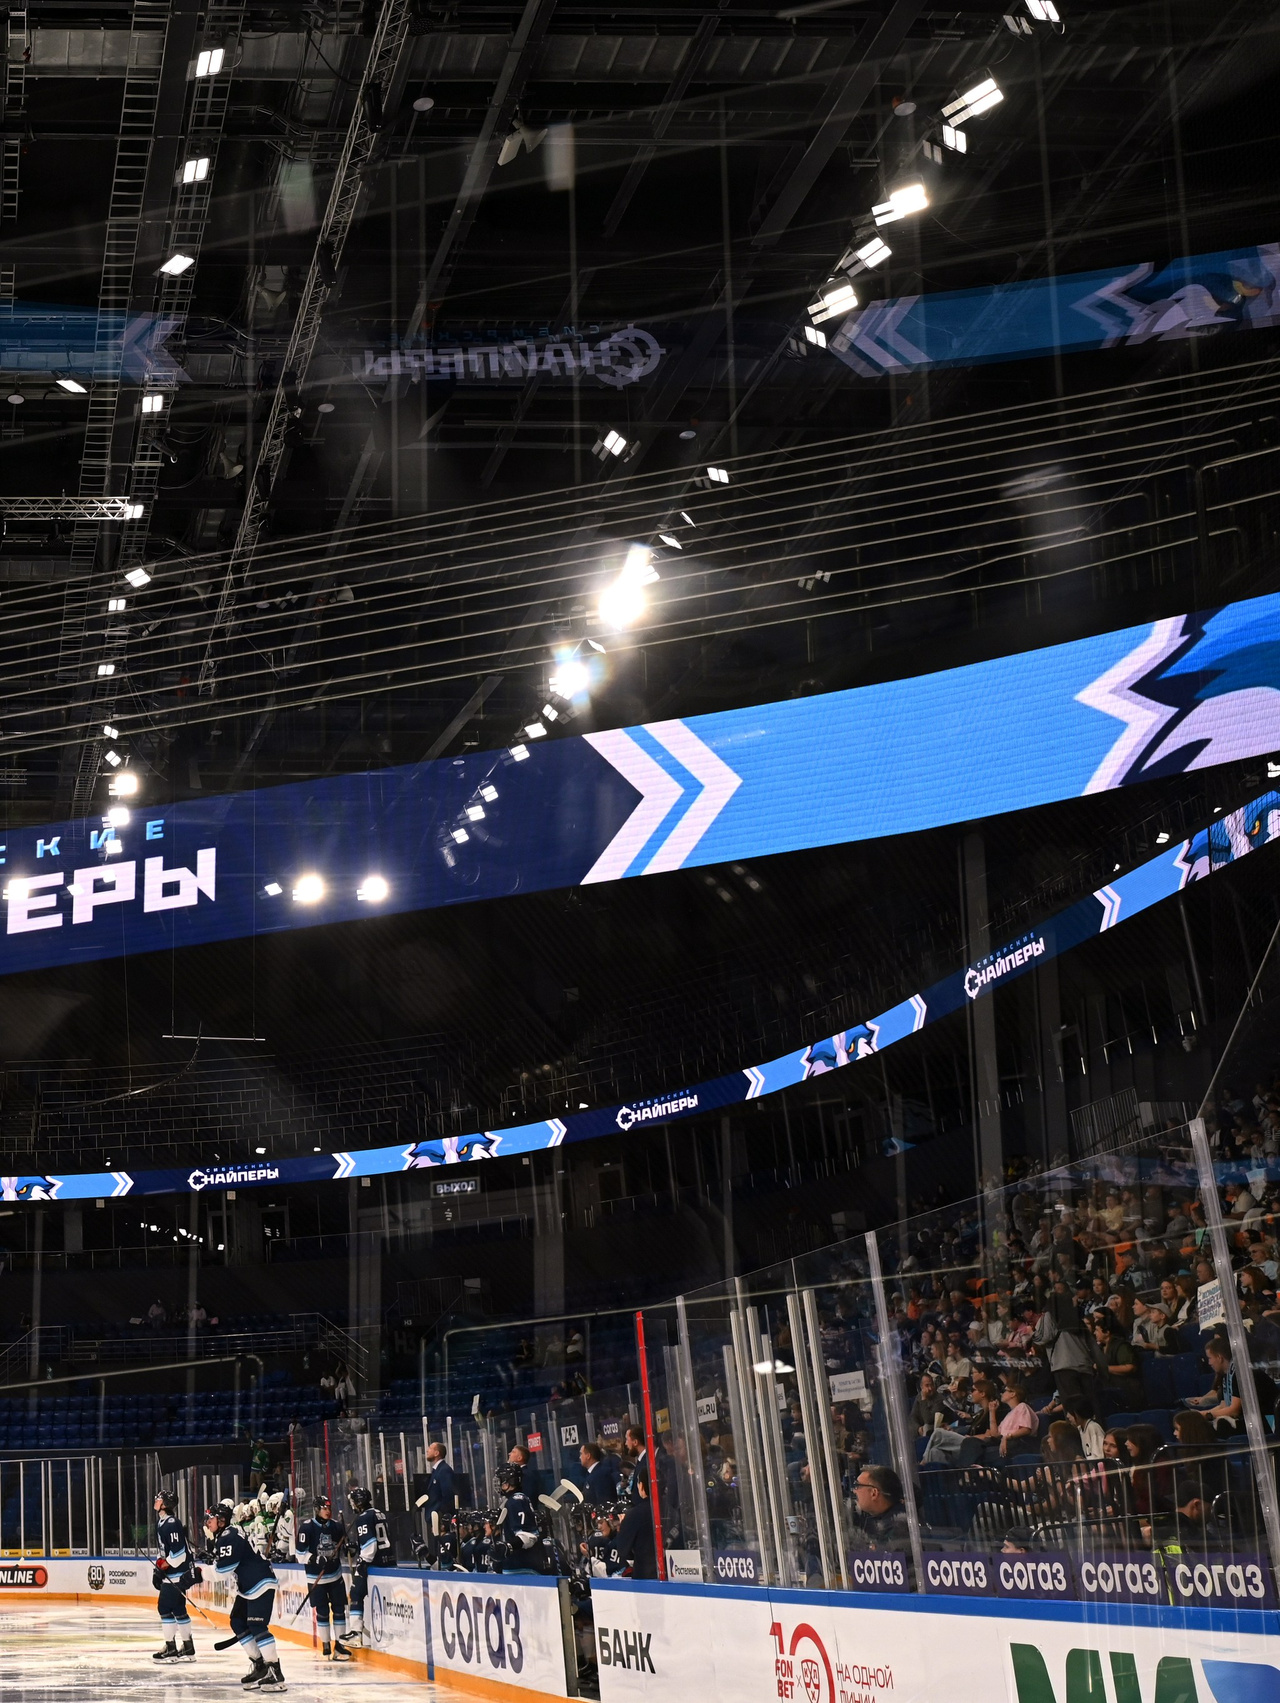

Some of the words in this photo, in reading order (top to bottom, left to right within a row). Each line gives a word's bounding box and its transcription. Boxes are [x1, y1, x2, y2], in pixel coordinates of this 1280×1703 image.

[963, 937, 1045, 1000] СНАЙПЕРЫ
[615, 1094, 698, 1131] СНАЙПЕРЫ
[187, 1168, 279, 1192] СНАЙПЕРЫ
[436, 1180, 477, 1194] ВЫХОД
[170, 1532, 179, 1543] 14
[357, 1525, 368, 1536] 95
[220, 1545, 232, 1558] 53
[90, 1566, 102, 1581] 80
[598, 1627, 656, 1674] БАНК
[775, 1659, 794, 1679] FON
[836, 1662, 852, 1683] НА
[852, 1664, 894, 1691] ОДНОЙ
[777, 1679, 795, 1699] BET
